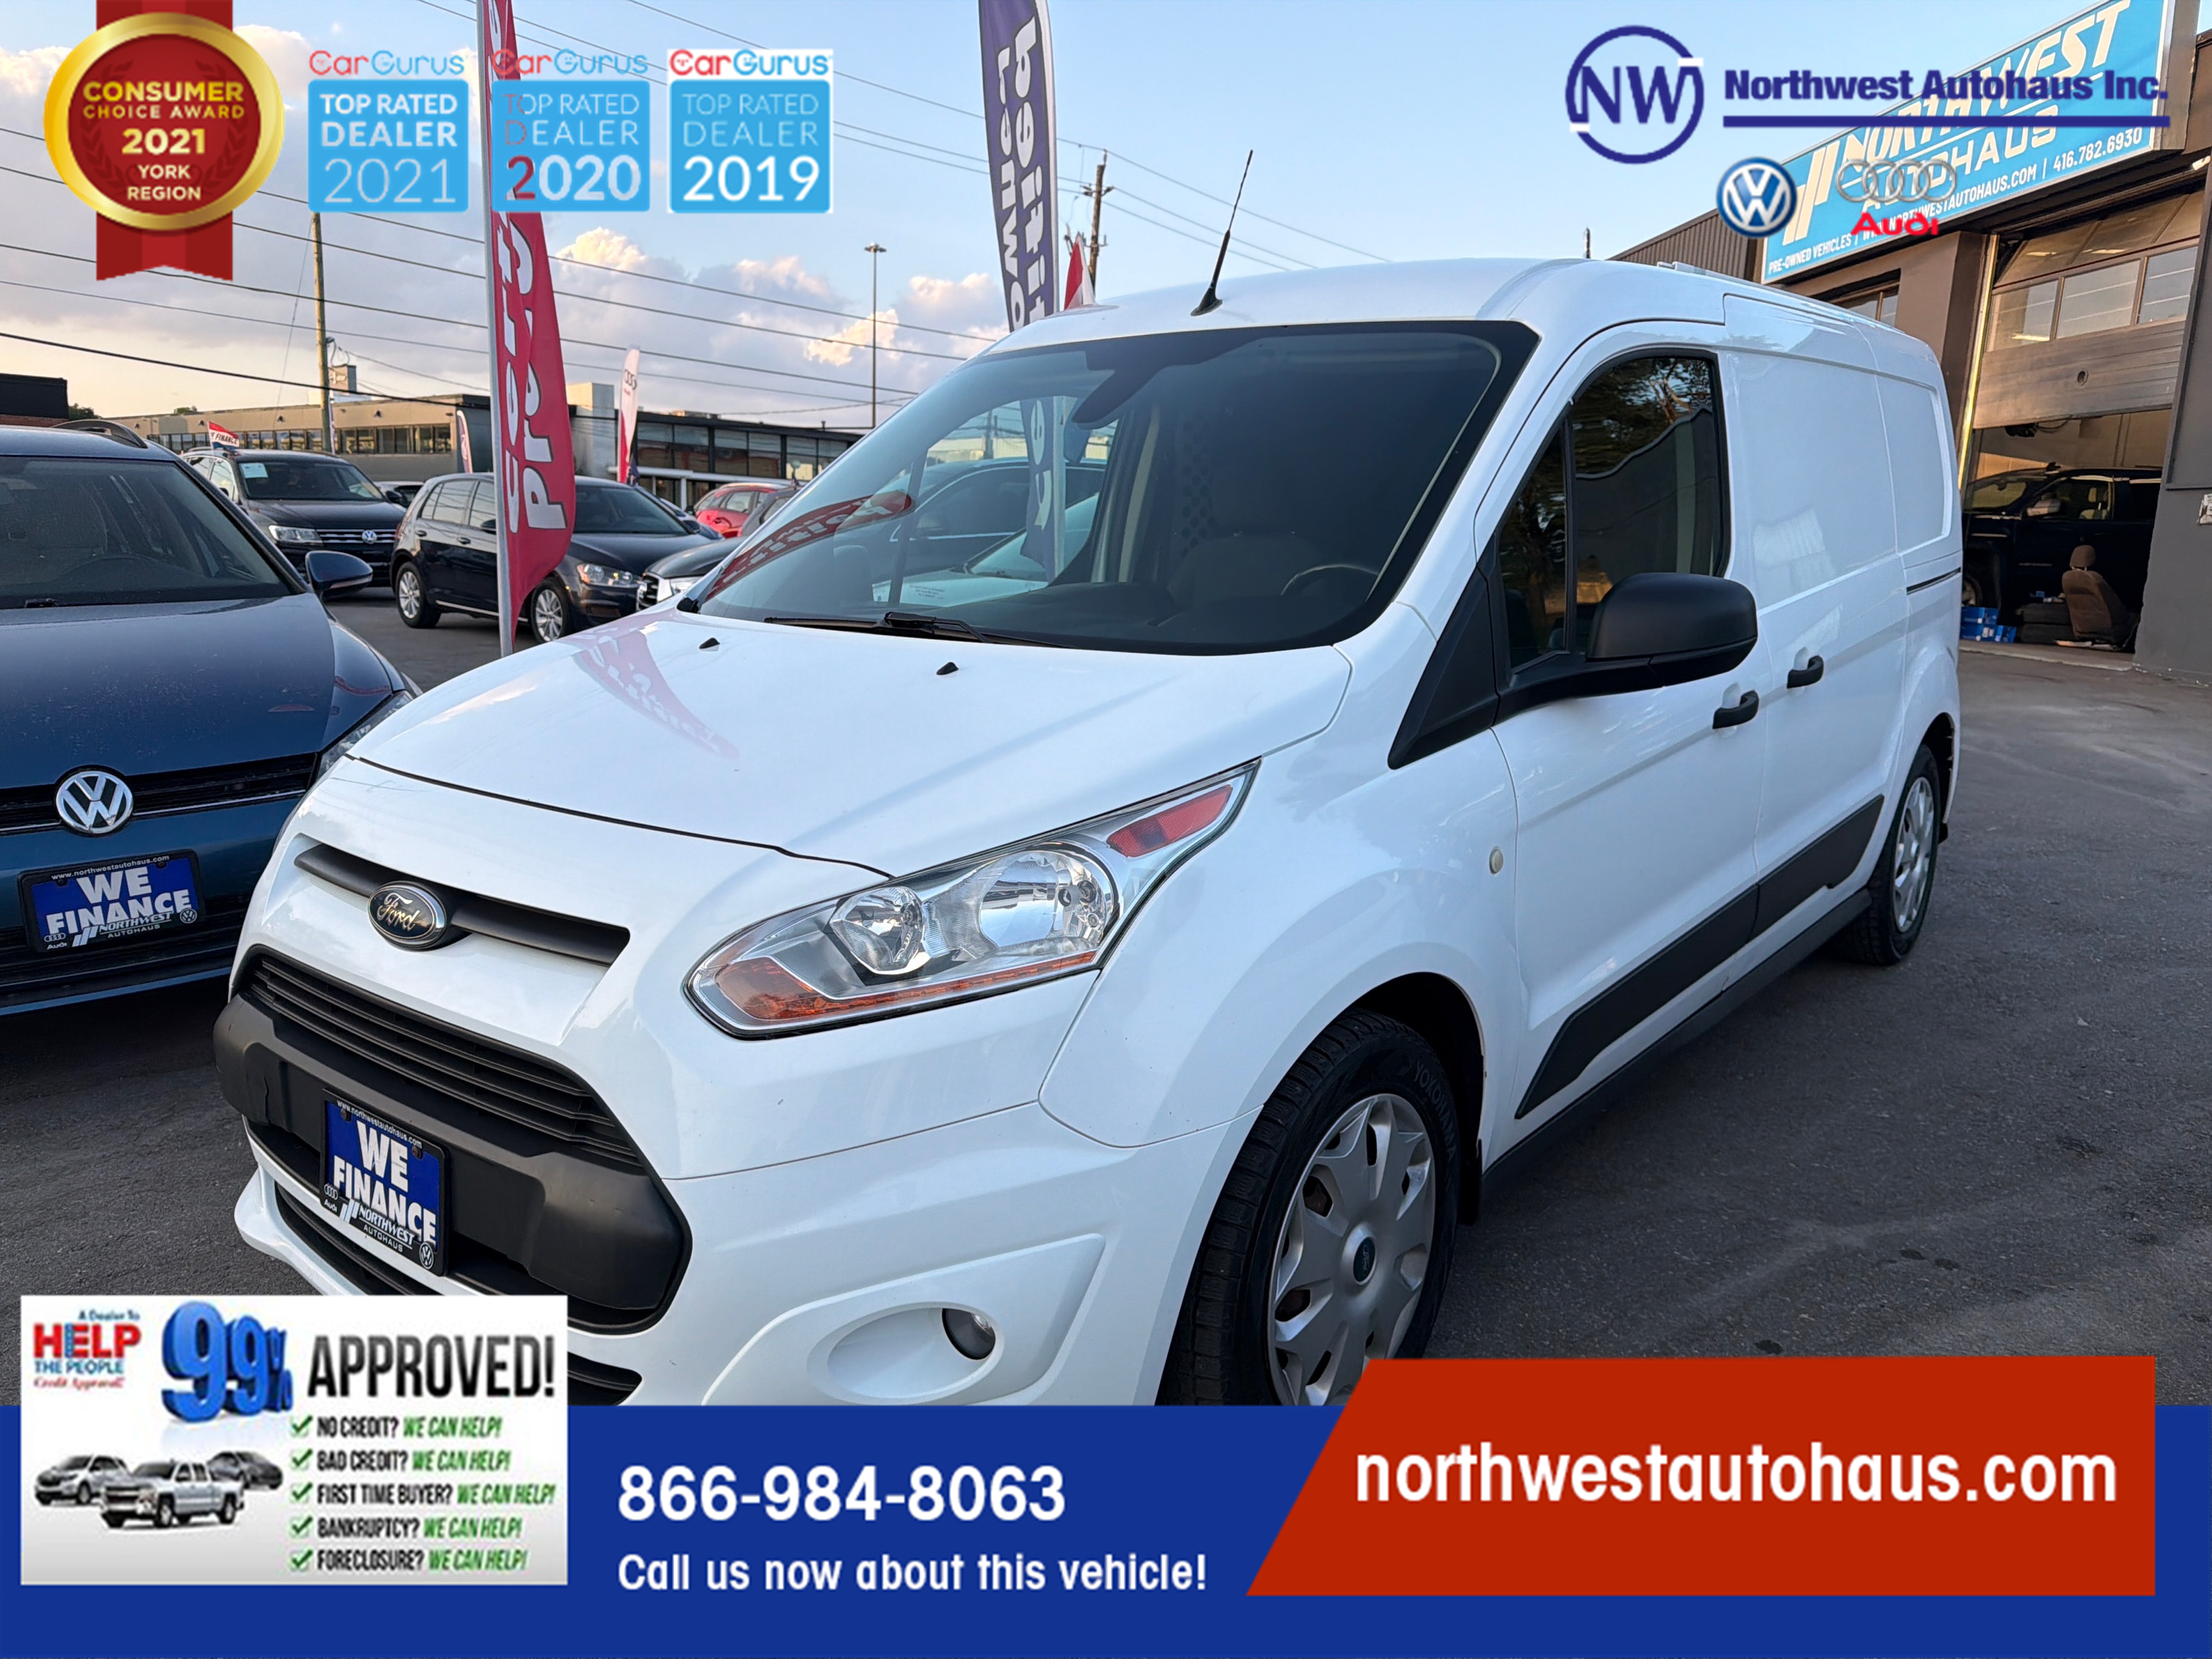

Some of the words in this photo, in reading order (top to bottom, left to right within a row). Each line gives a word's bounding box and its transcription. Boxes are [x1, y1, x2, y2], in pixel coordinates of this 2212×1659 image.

[1768, 248, 1812, 275] PRE-OWNED
[1813, 233, 1852, 258] VEHICLES
[2053, 127, 2143, 172] 416.782.6930
[51, 855, 170, 881] www.northwestautohaus.com
[76, 866, 152, 904] WE
[45, 889, 192, 935] FINANCE
[98, 912, 173, 932] NORTHWEST
[107, 924, 161, 939] AUTOHAUS
[377, 892, 421, 932] Ford
[336, 1100, 423, 1149] www.northwestautohaus.com
[356, 1120, 409, 1193] WE
[333, 1155, 437, 1249] FINANCE
[359, 1204, 416, 1246] NORTHWEST
[363, 1224, 404, 1253] AUTOHAUS
